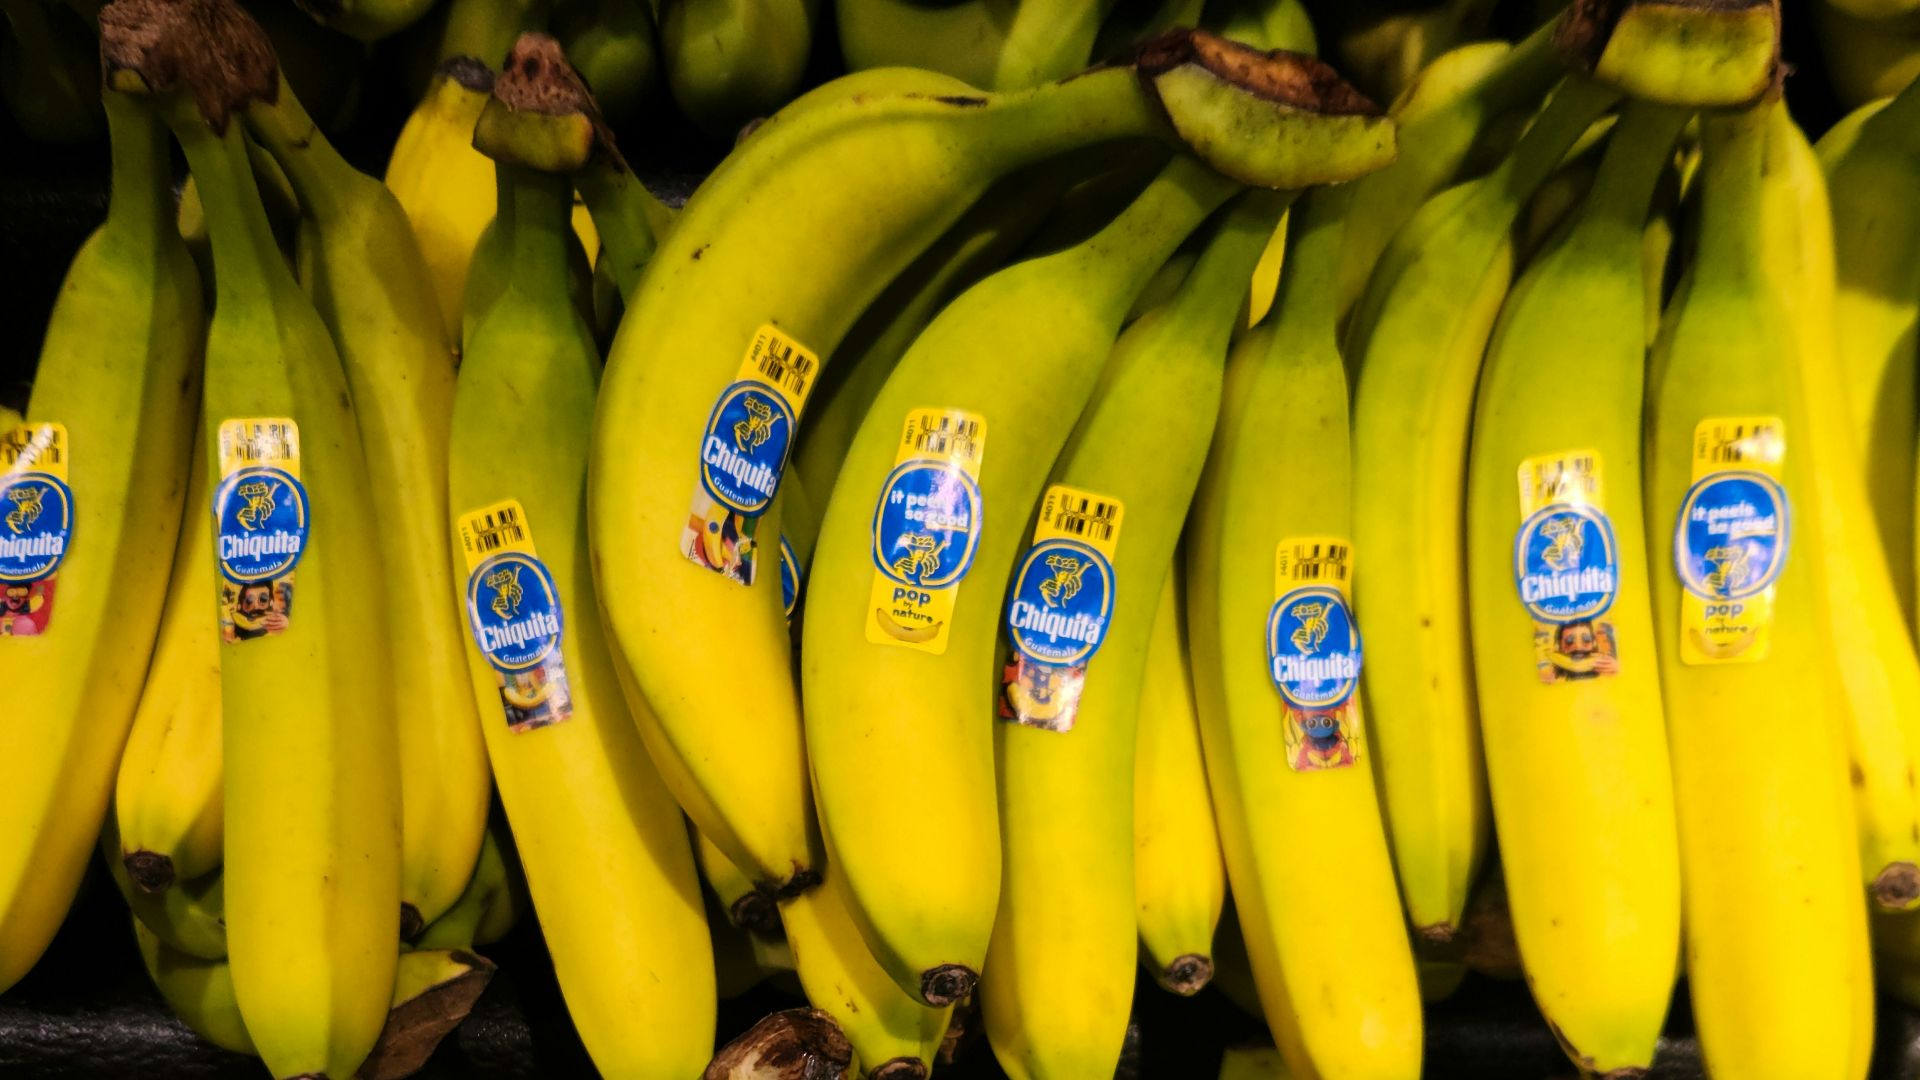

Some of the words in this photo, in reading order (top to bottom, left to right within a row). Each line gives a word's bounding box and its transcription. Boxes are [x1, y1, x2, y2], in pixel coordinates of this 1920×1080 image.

[703, 434, 777, 499] Chiquita
[714, 476, 757, 506] Guatemala
[891, 490, 905, 504] it
[905, 509, 925, 522] so
[0, 531, 64, 563] hiquita
[219, 529, 301, 562] Chiquita
[235, 561, 283, 575] Guatemala
[1521, 567, 1614, 602] Chiquita
[893, 587, 931, 608] pop
[903, 600, 914, 610] by
[892, 608, 933, 624] nature
[1010, 600, 1102, 645] Chiquita
[1704, 604, 1744, 620] pop
[479, 611, 560, 653] Chiquita
[1024, 637, 1077, 658] Guatemala
[1273, 653, 1356, 688] Chiquita
[1292, 687, 1341, 701] Guatemala
